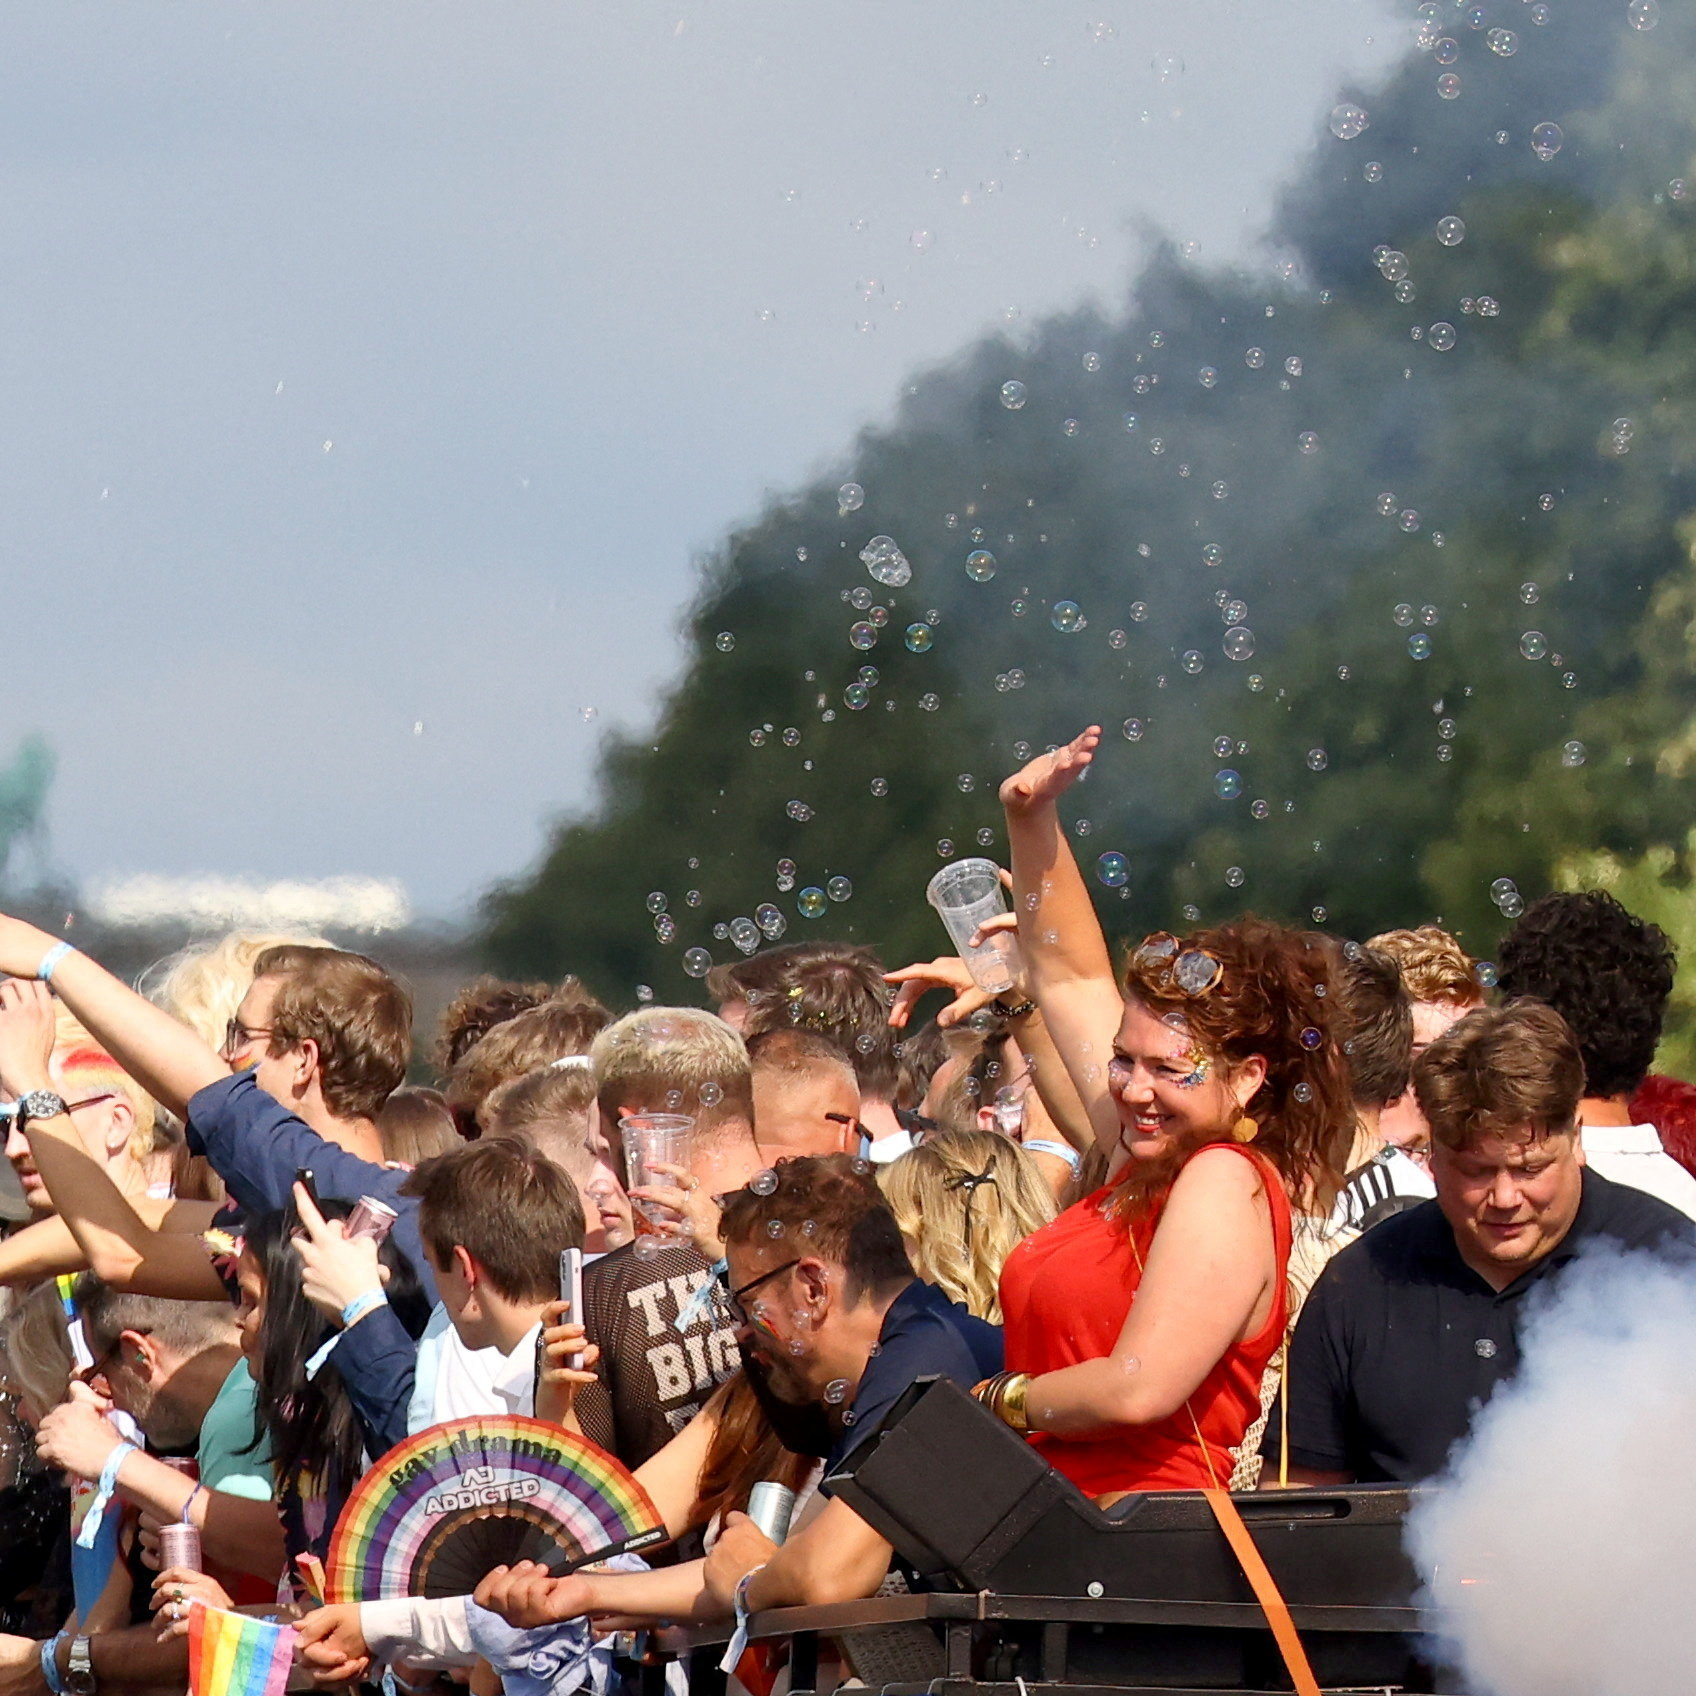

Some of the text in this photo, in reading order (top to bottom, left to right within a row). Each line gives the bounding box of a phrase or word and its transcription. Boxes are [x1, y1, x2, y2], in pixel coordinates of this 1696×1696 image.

[646, 1328, 743, 1401] BIG
[424, 1478, 541, 1517] ADDICTED
[623, 1531, 662, 1551] ADDICTED
